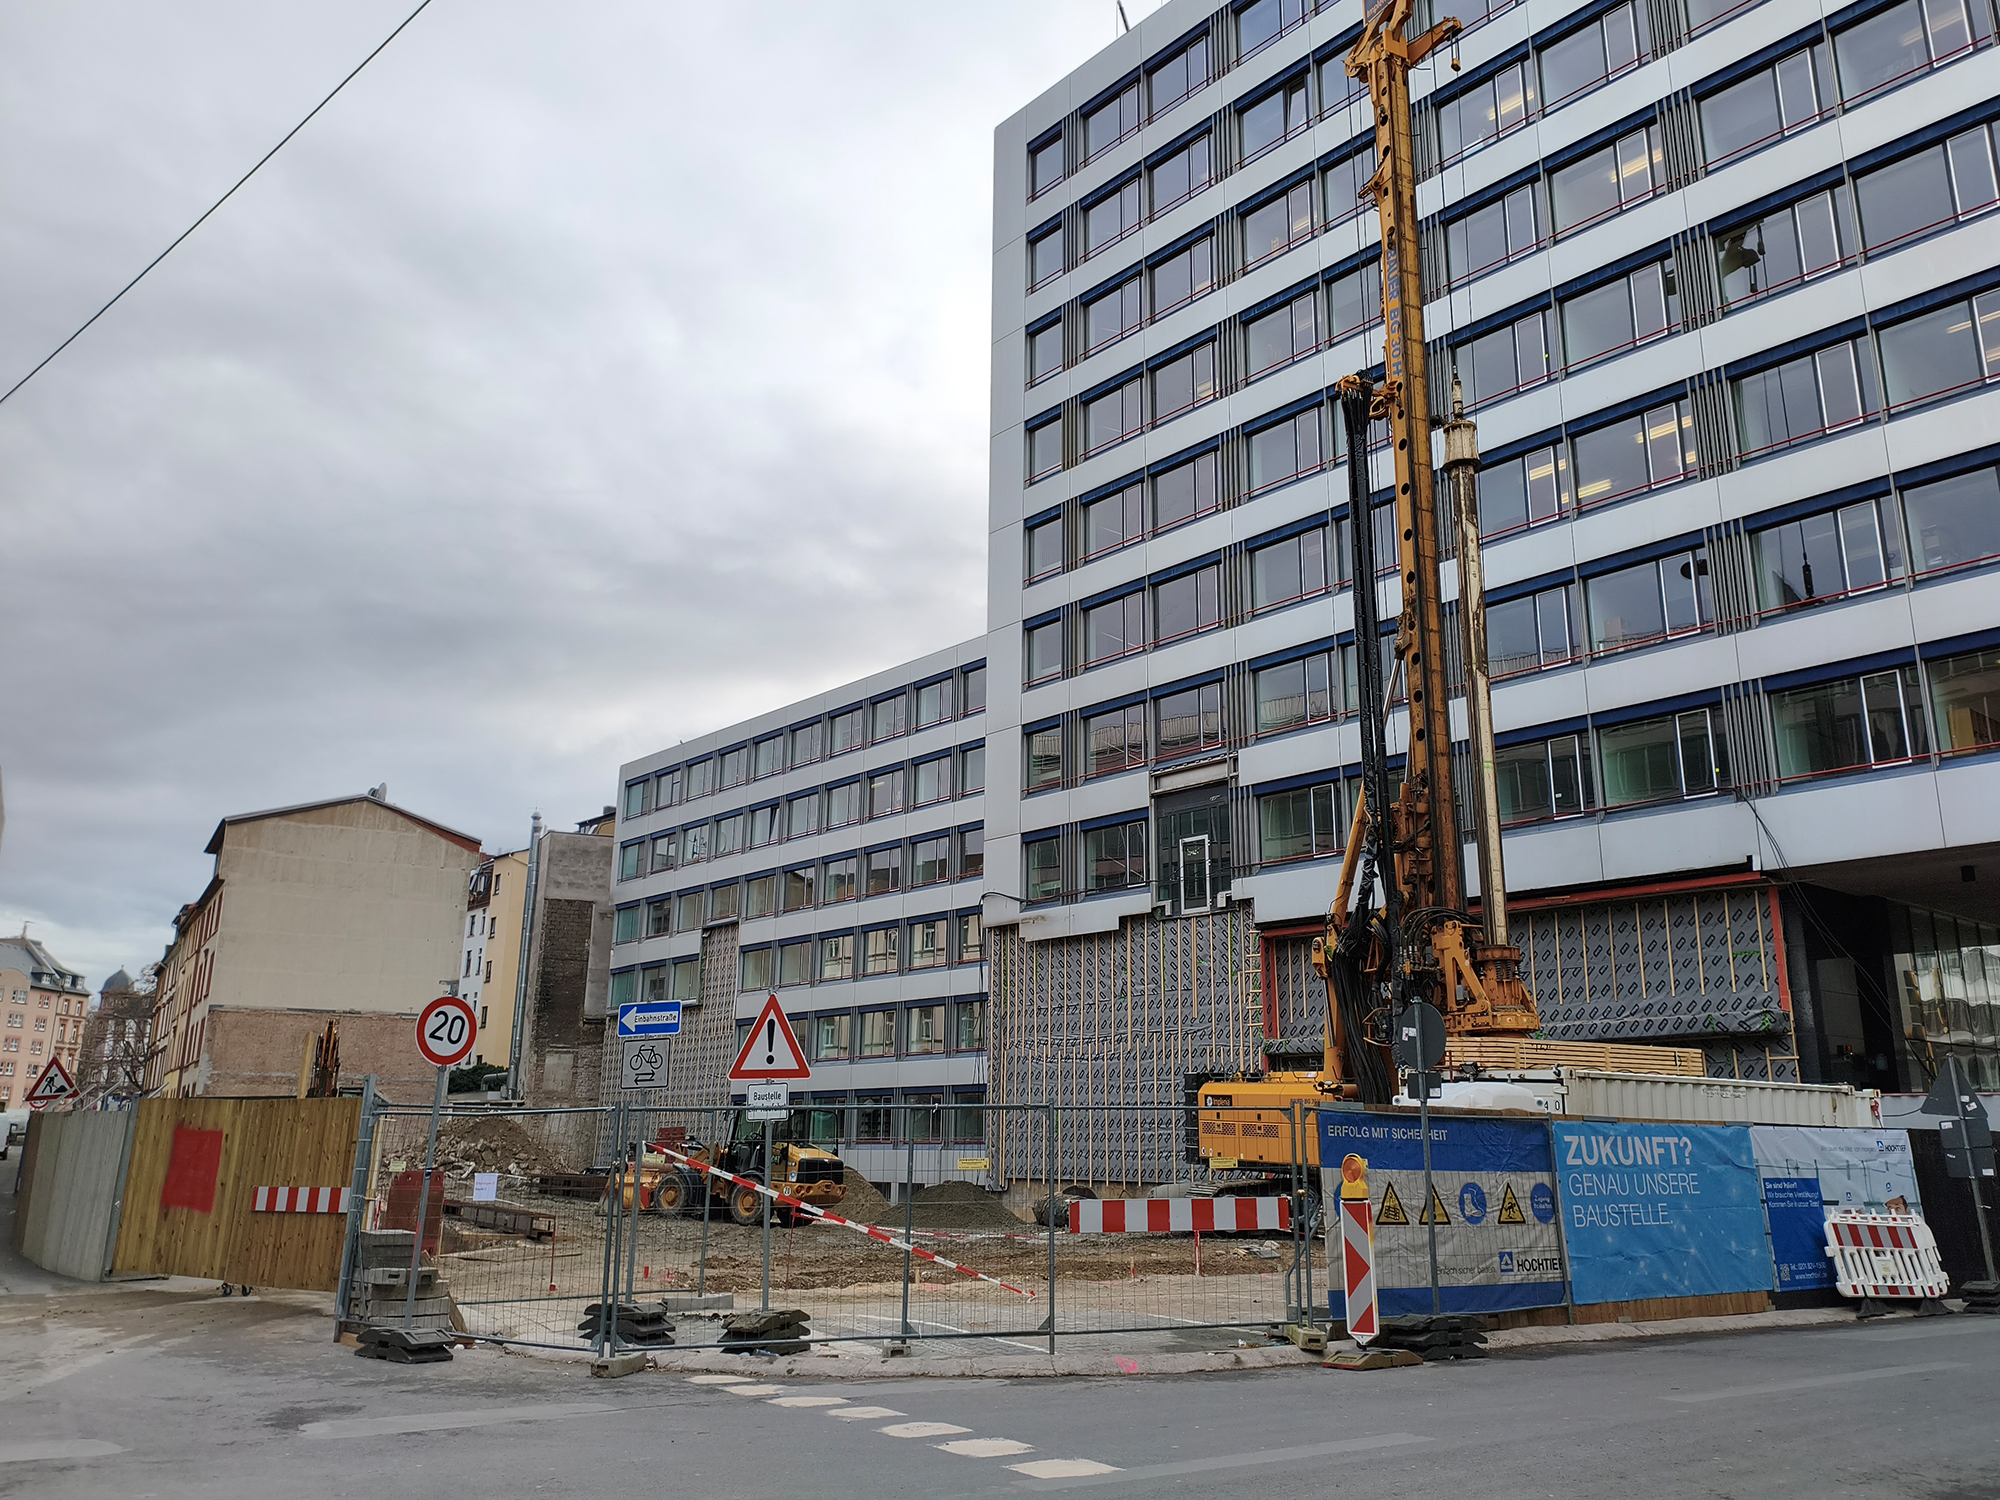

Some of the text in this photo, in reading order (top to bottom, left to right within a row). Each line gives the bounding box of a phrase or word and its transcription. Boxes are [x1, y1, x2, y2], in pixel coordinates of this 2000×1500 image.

[1387, 249, 1399, 303] BAUER
[1390, 308, 1401, 334] BG
[428, 1010, 466, 1045] 20
[634, 1013, 677, 1023] Einbahnstraße
[753, 1091, 782, 1101] Baustelle
[1327, 1125, 1369, 1138] ERFOLG
[1371, 1127, 1388, 1139] MIT
[1563, 1135, 1693, 1166] ZUKUNFT?
[1885, 1144, 1906, 1152] HOCHTIEF
[1568, 1173, 1700, 1197] GENAU UNSERE
[1773, 1181, 1783, 1189] sind
[1572, 1203, 1674, 1228] BAUSTELLE.
